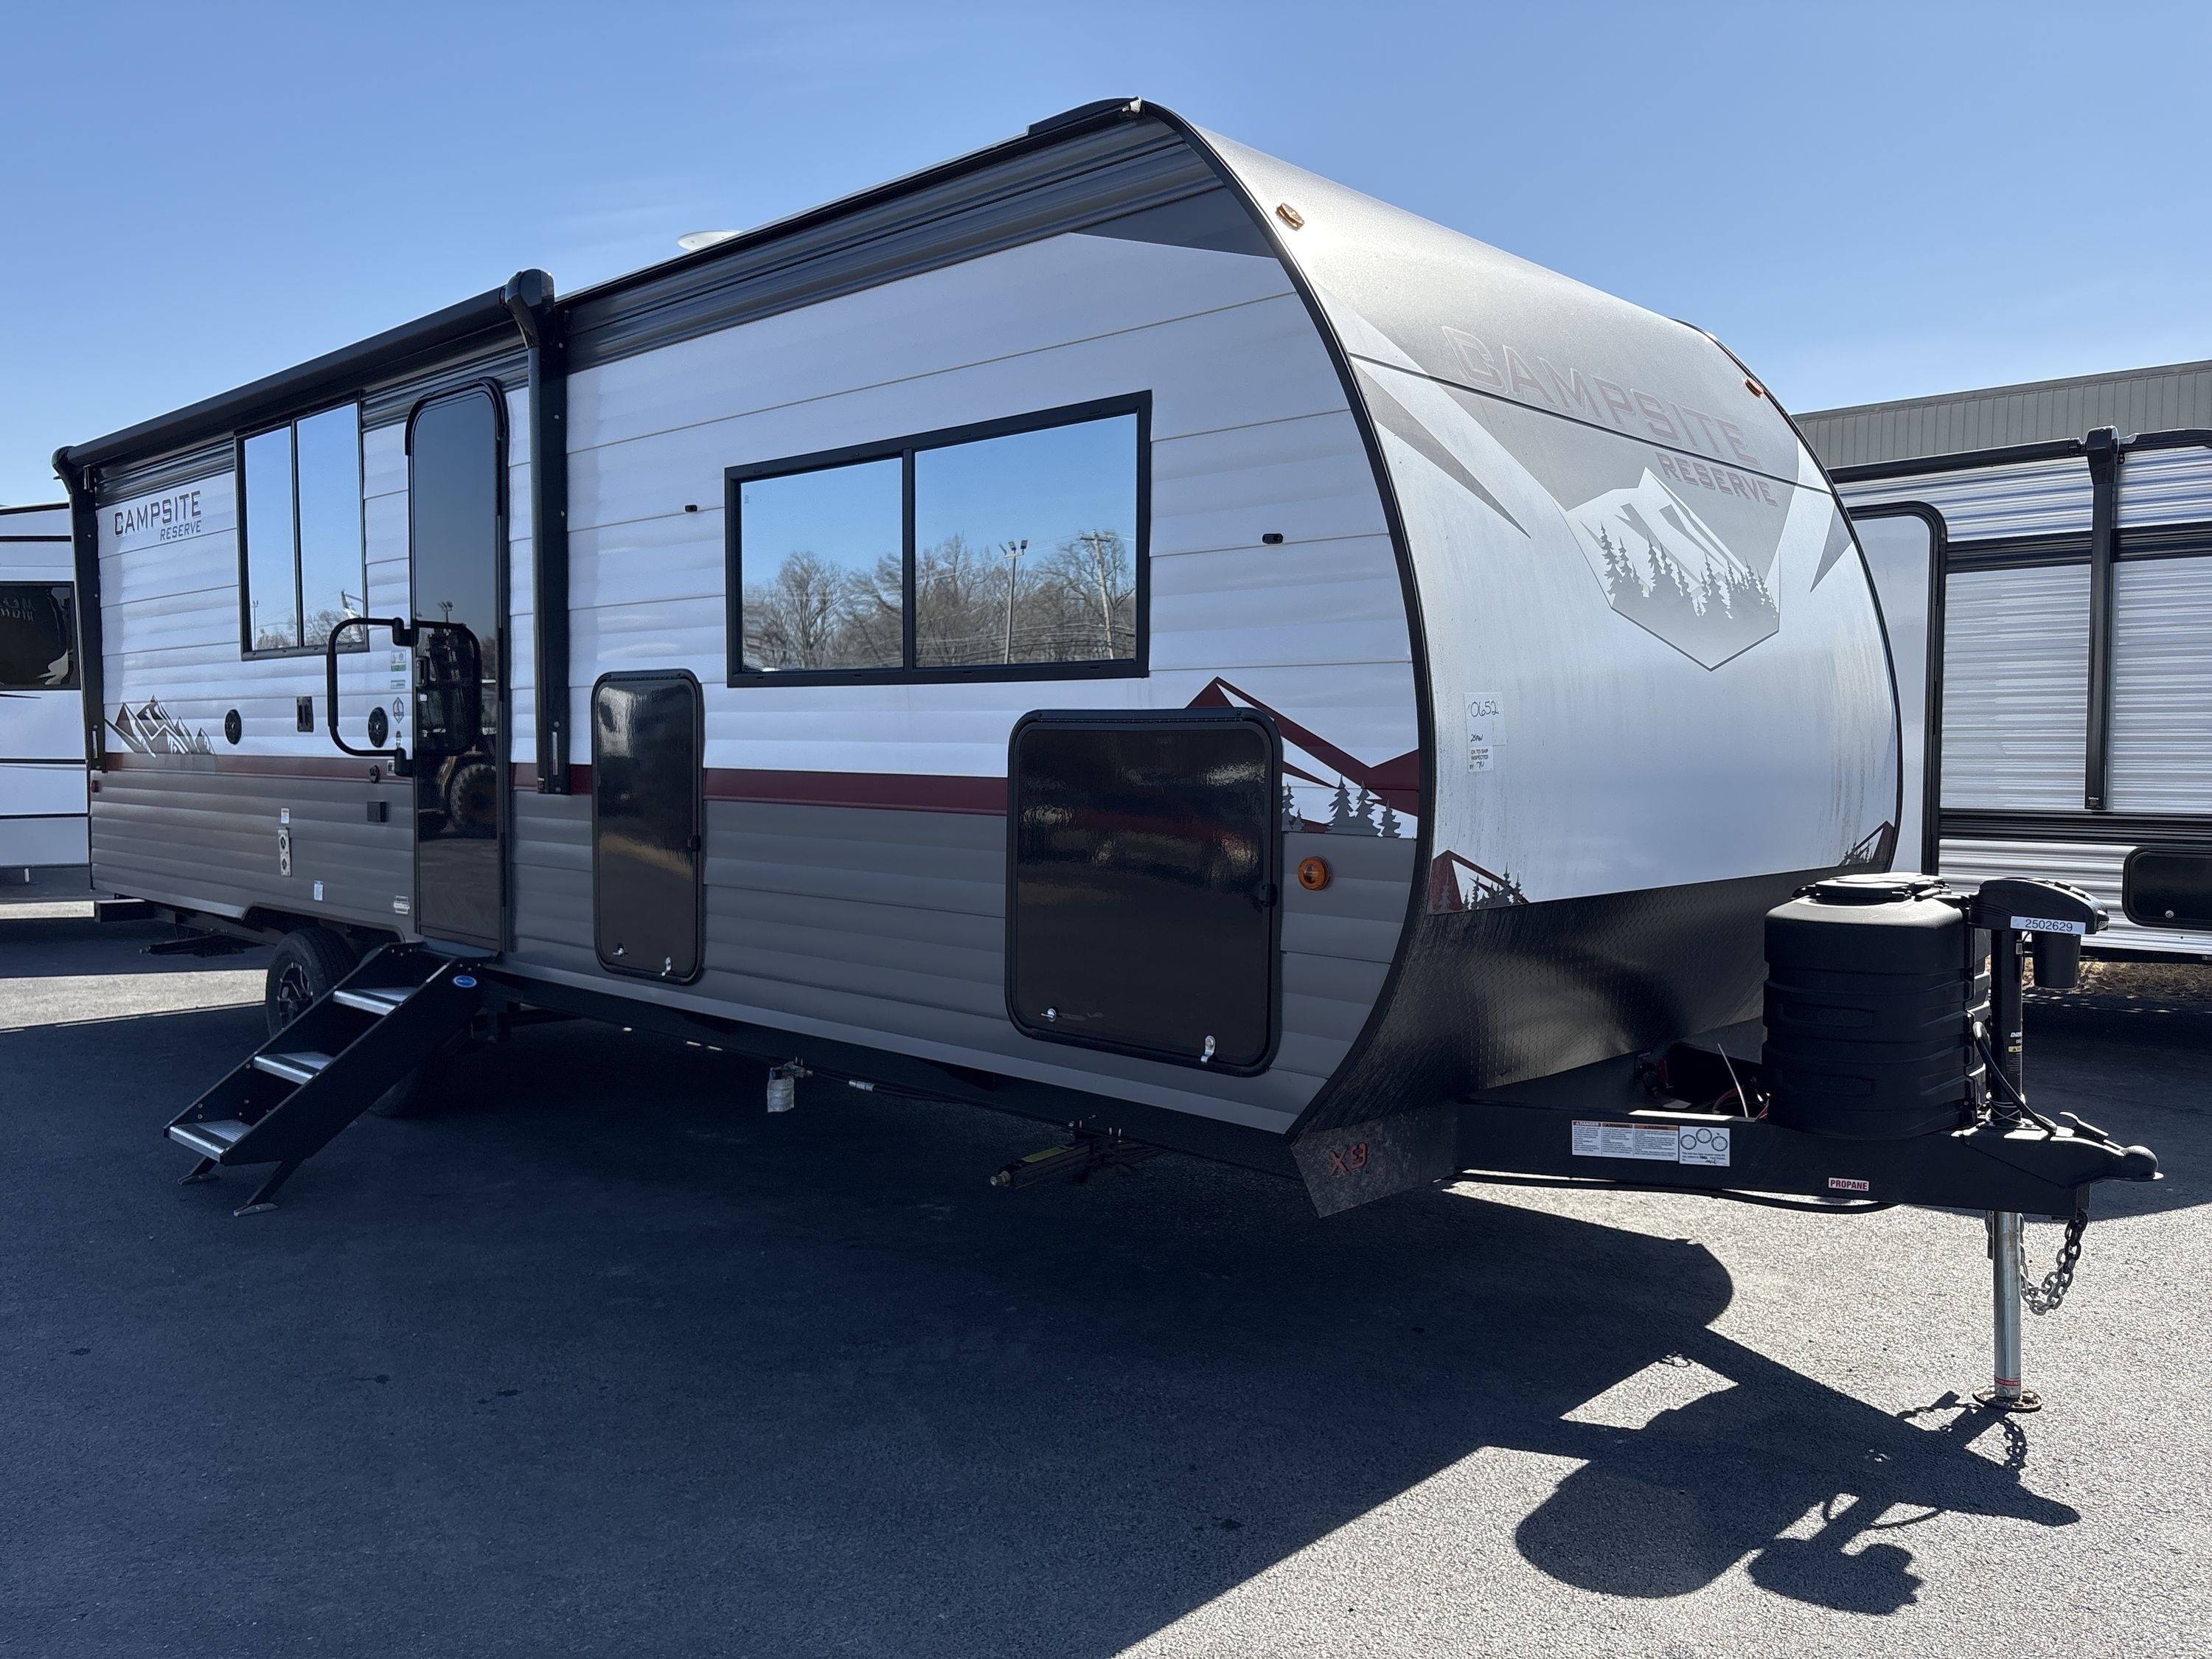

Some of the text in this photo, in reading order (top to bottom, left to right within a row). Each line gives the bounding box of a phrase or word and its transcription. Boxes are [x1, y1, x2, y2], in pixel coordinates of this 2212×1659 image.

[1441, 325, 1761, 470] CAMPSITE
[1655, 451, 1778, 507] RESERVE
[114, 490, 201, 536] CAMPSITE
[160, 520, 202, 541] RESERVE
[1470, 700, 1500, 717] 0652
[2025, 918, 2073, 932] 2502629
[1830, 1179, 1868, 1190] PROPANE
